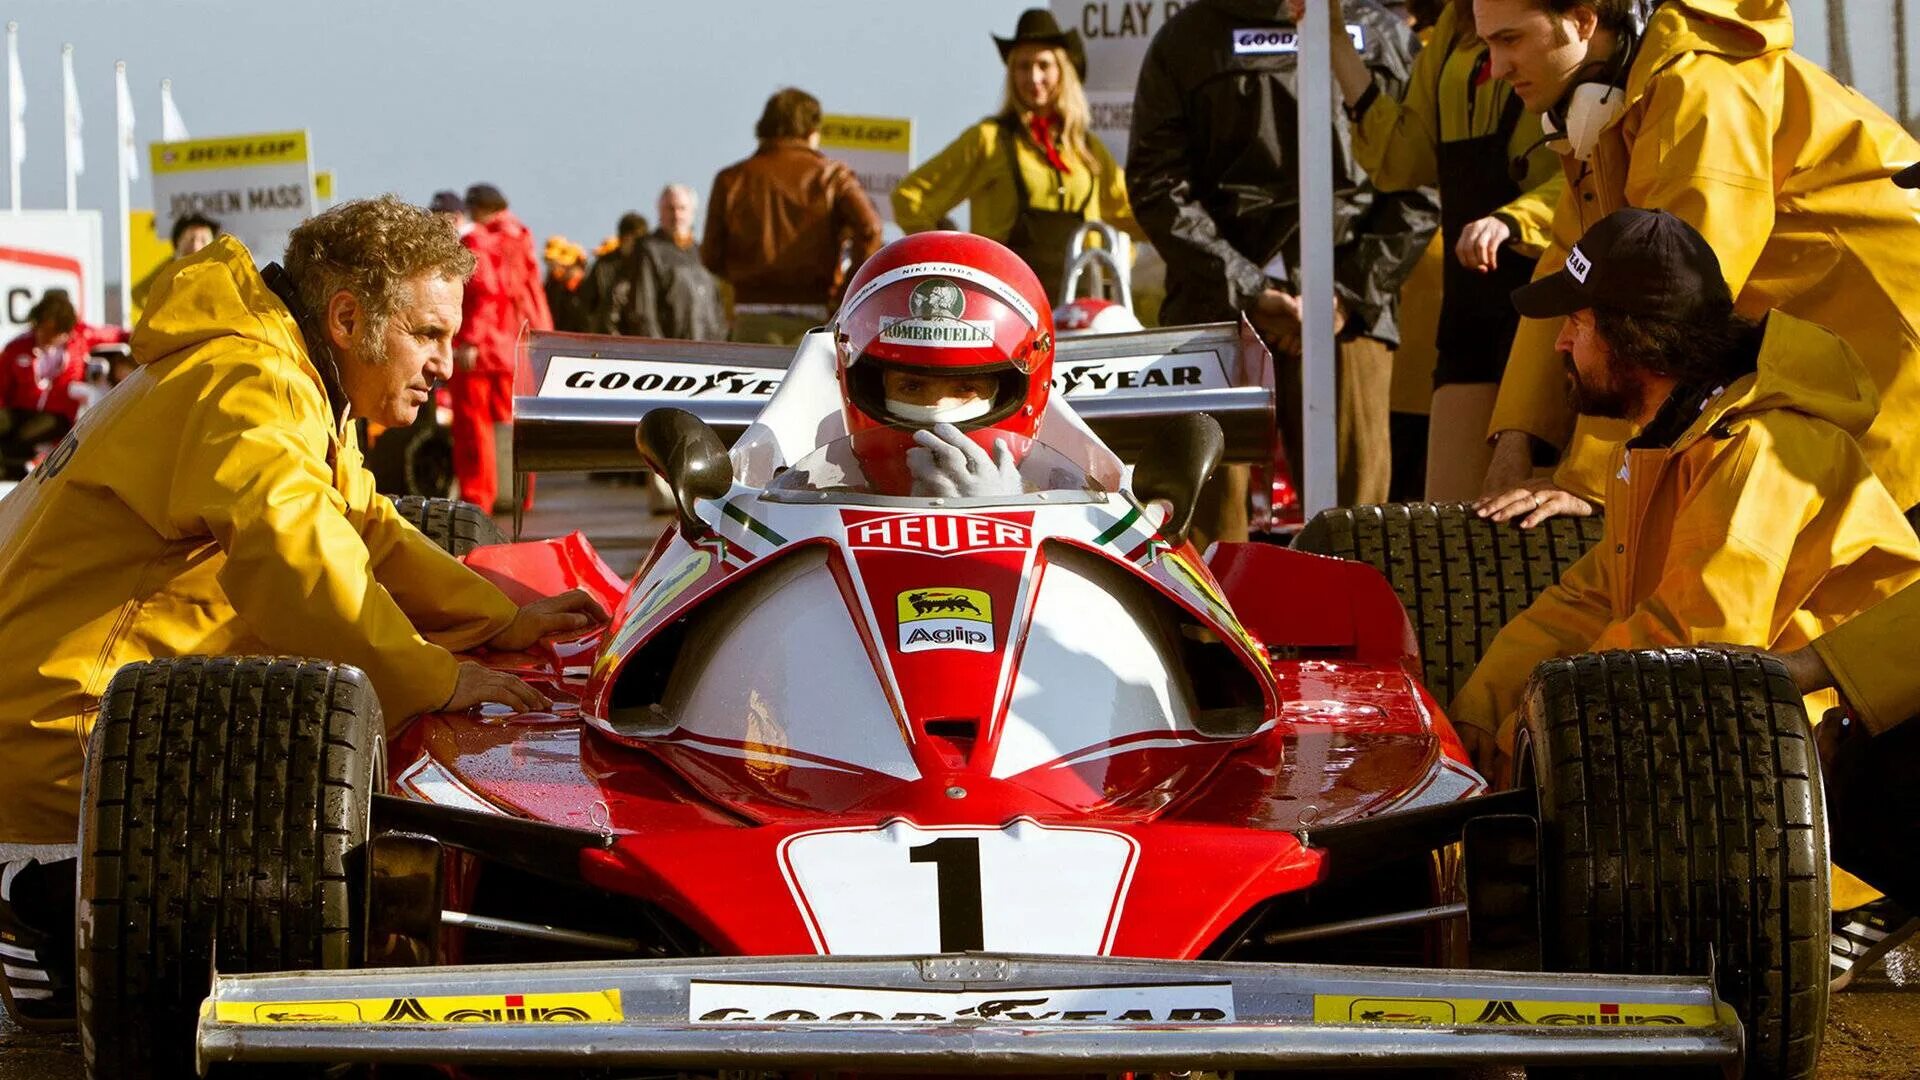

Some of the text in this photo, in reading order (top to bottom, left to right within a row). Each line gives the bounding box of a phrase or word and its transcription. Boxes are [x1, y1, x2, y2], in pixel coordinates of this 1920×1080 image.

[1083, 4, 1152, 37] CLAY
[1240, 33, 1298, 46] GOOD
[186, 139, 296, 162] DUNLOP
[247, 184, 305, 211] MASS
[902, 266, 927, 275] NIKI
[1050, 363, 1203, 397] YEAR
[861, 517, 1025, 552] HEUER
[905, 626, 988, 645] Agip
[909, 837, 985, 953] 1
